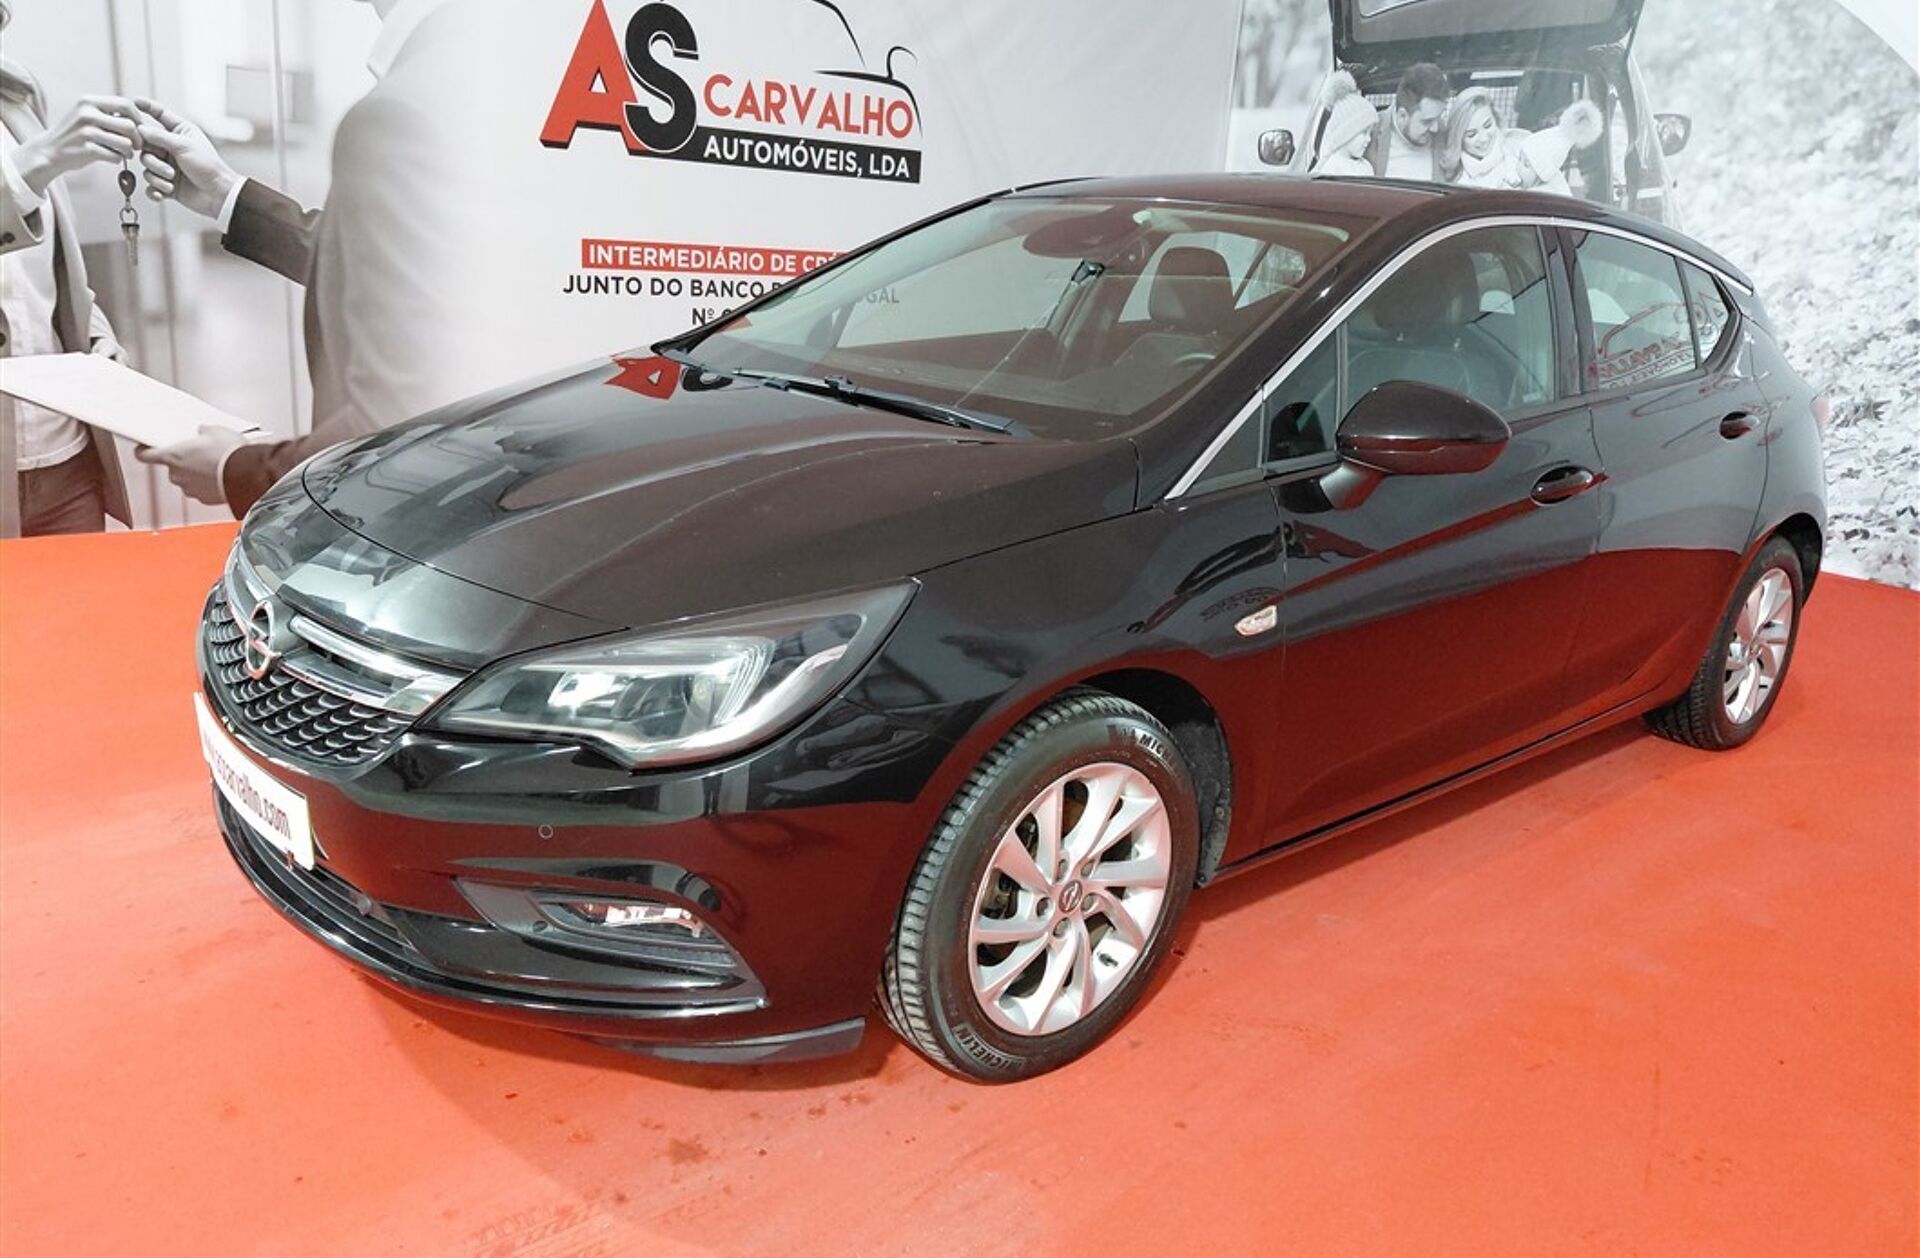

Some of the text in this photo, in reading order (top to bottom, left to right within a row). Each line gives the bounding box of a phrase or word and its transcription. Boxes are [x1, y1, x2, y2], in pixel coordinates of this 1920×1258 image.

[539, 0, 914, 156] AS CARVALHO
[703, 135, 910, 178] AUTOMÓVEIS, LDA
[589, 244, 764, 272] INTERMEDIÁRIO
[770, 254, 797, 272] DE
[563, 275, 642, 296] JUNTO
[651, 278, 683, 296] DO
[690, 279, 764, 298] BANCO
[202, 728, 292, 840] .ascarvalho.com
[951, 1024, 1023, 1070] MICHELIN
